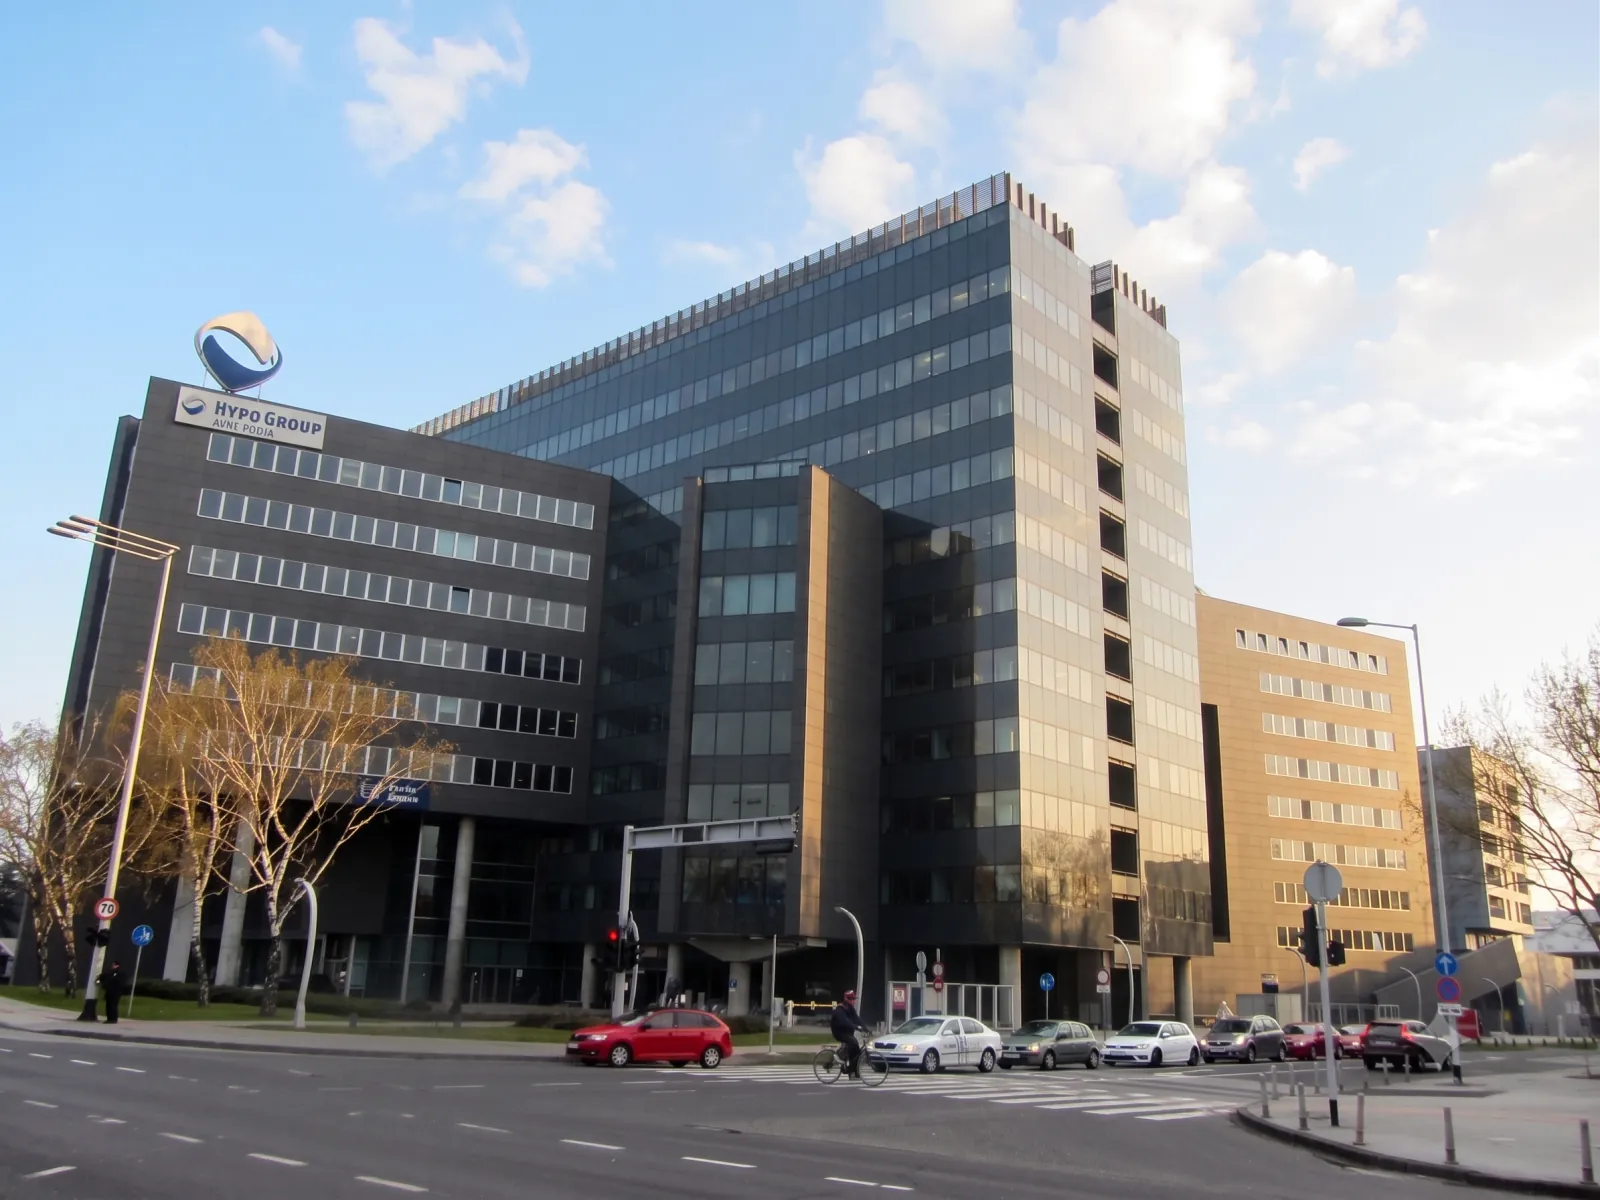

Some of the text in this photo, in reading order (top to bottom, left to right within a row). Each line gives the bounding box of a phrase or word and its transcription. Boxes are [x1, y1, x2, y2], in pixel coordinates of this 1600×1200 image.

[214, 400, 322, 435] HYPO GROUP
[212, 418, 239, 431] AVNE
[101, 903, 114, 914] 70
